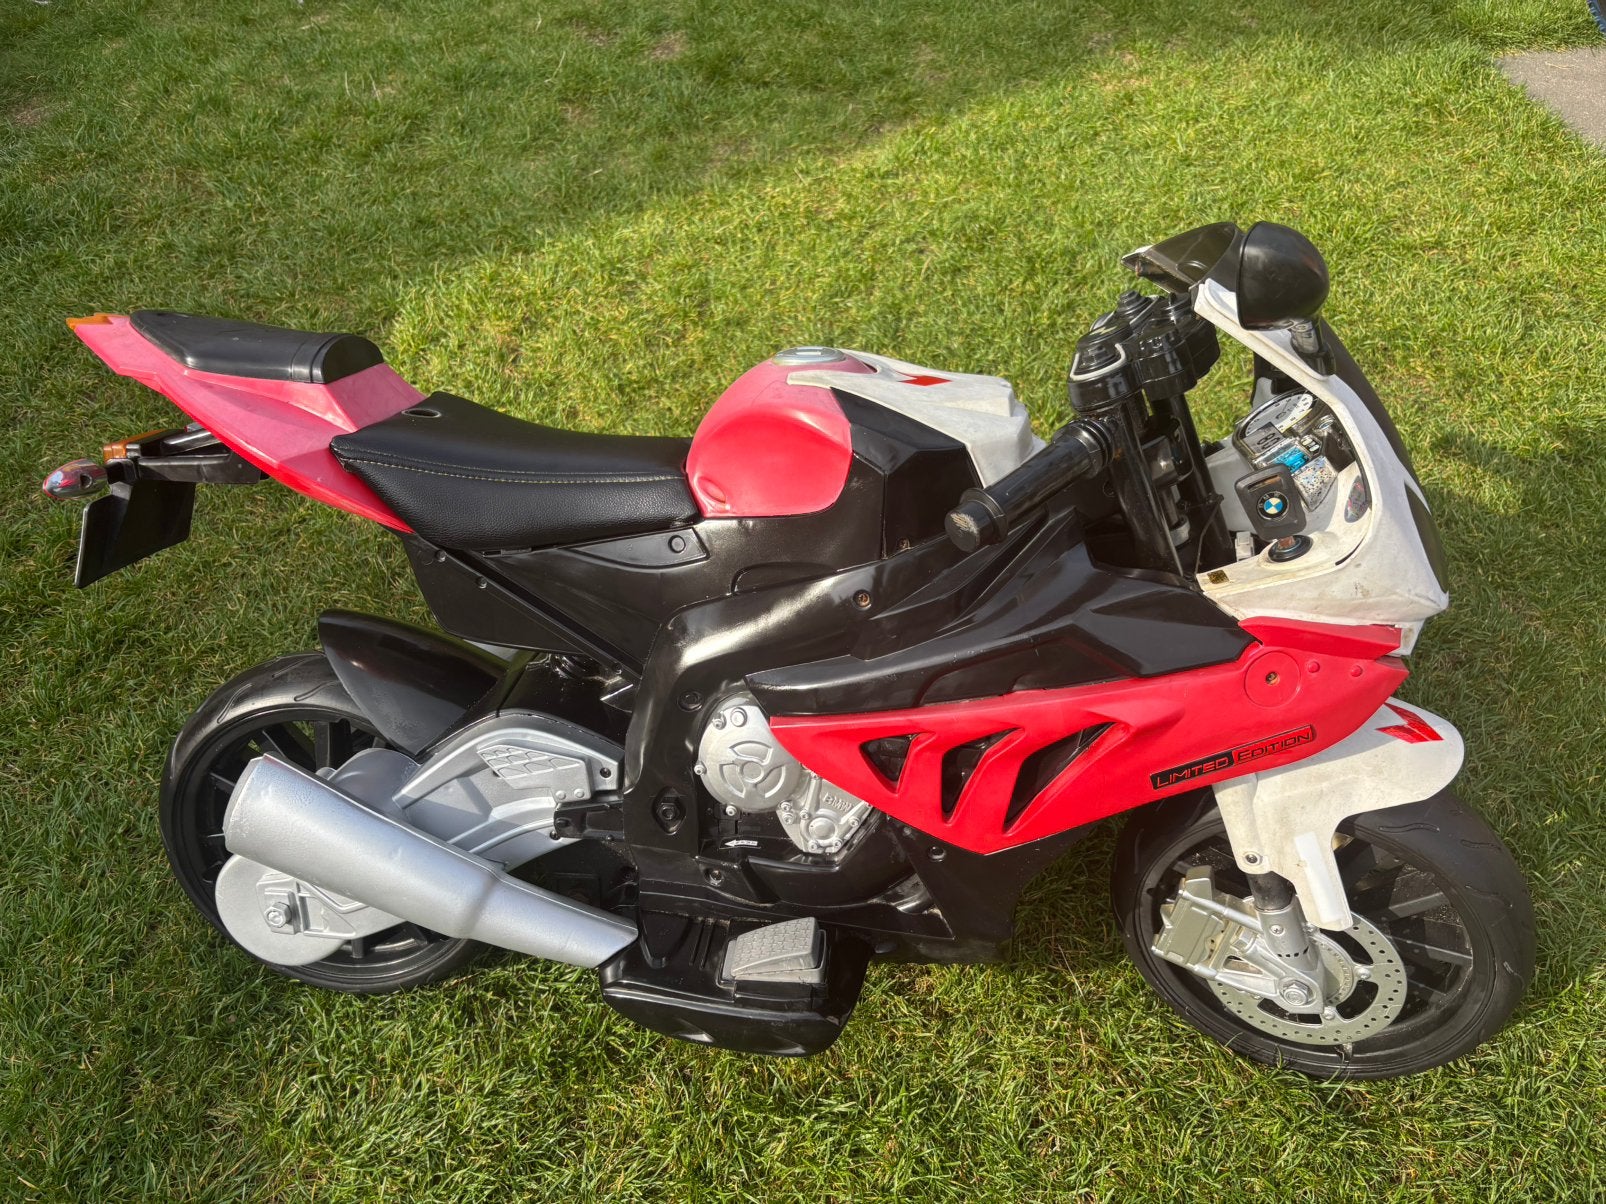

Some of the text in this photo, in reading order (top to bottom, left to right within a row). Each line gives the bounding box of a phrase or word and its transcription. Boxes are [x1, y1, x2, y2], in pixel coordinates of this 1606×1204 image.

[1157, 732, 1310, 788] LIMITED EDITION
[823, 792, 852, 813] BMW
